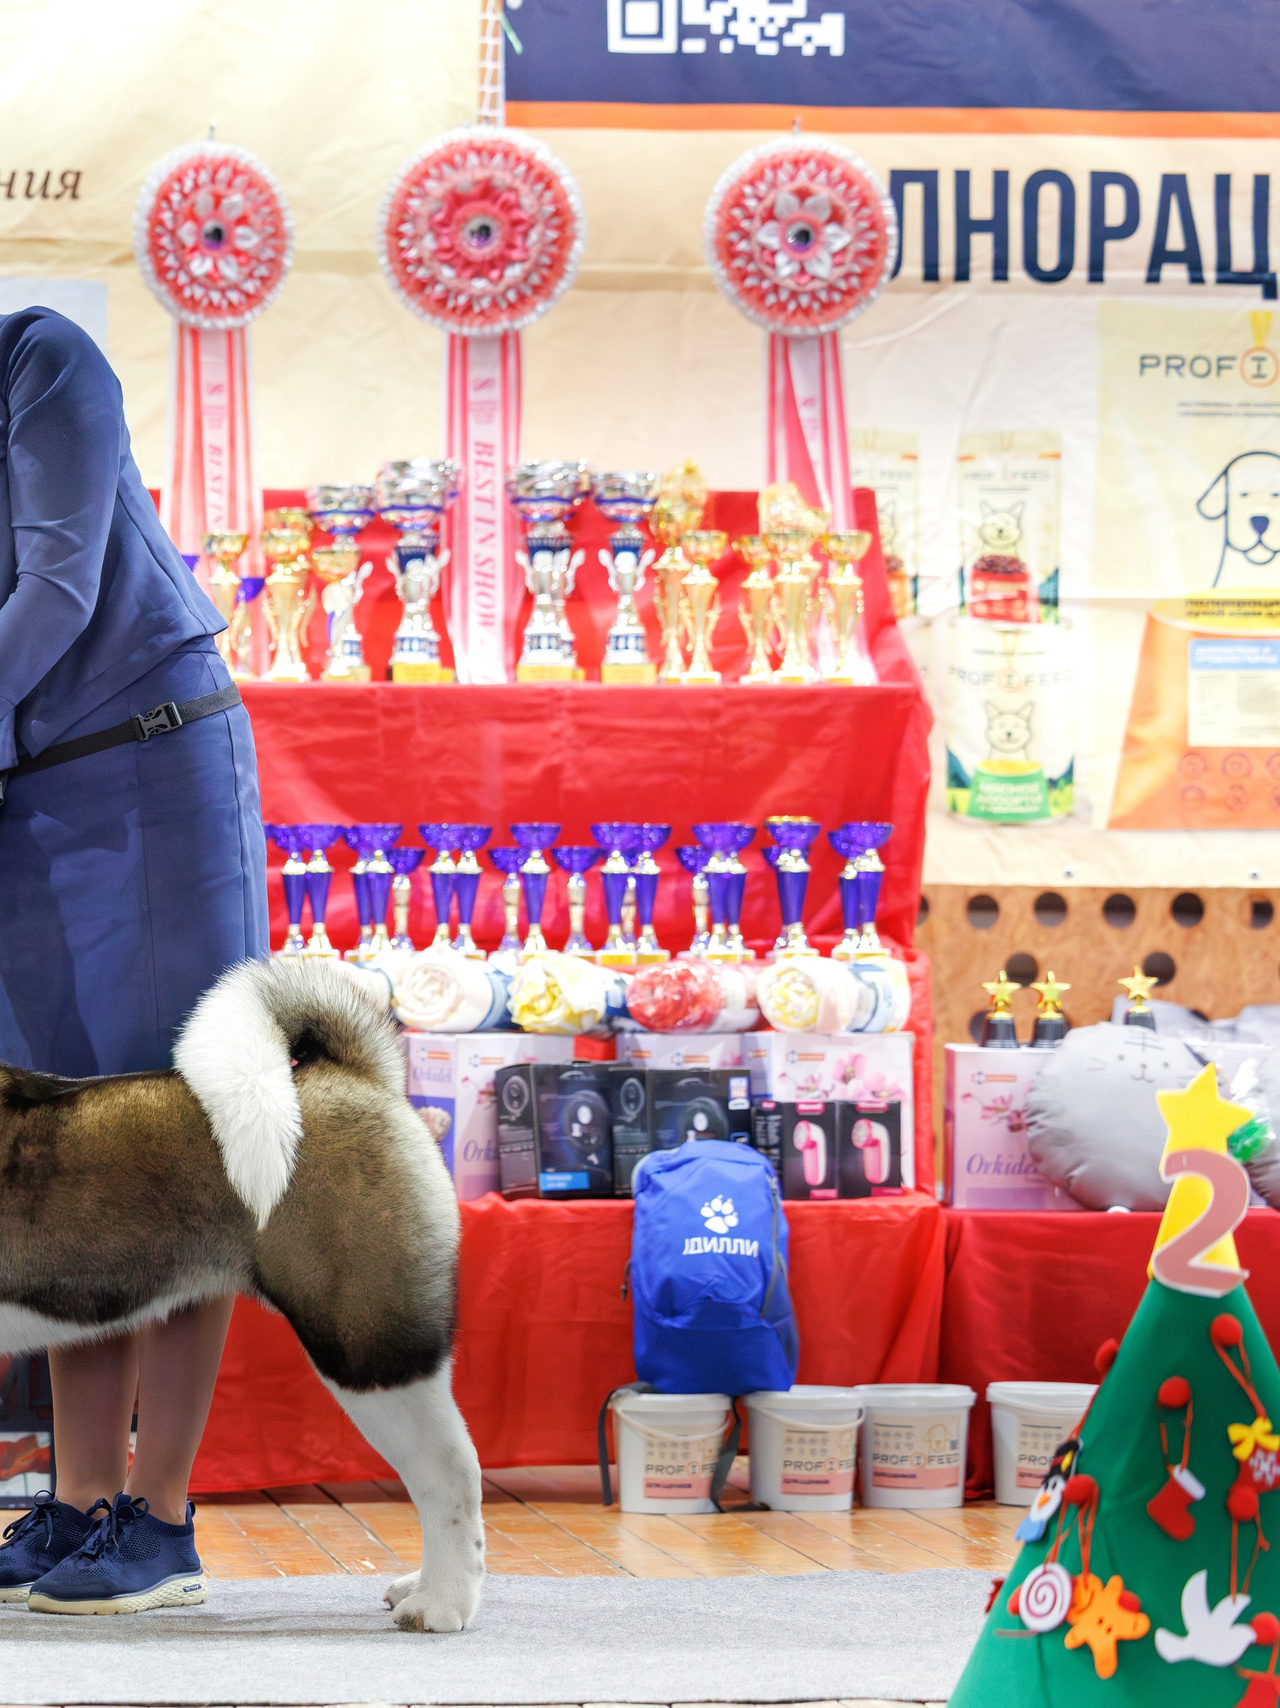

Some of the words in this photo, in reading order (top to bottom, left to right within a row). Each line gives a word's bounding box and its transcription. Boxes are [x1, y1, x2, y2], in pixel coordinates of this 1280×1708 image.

[474, 440, 496, 511] BEST
[475, 517, 497, 548] IN
[475, 553, 498, 627] SHOW
